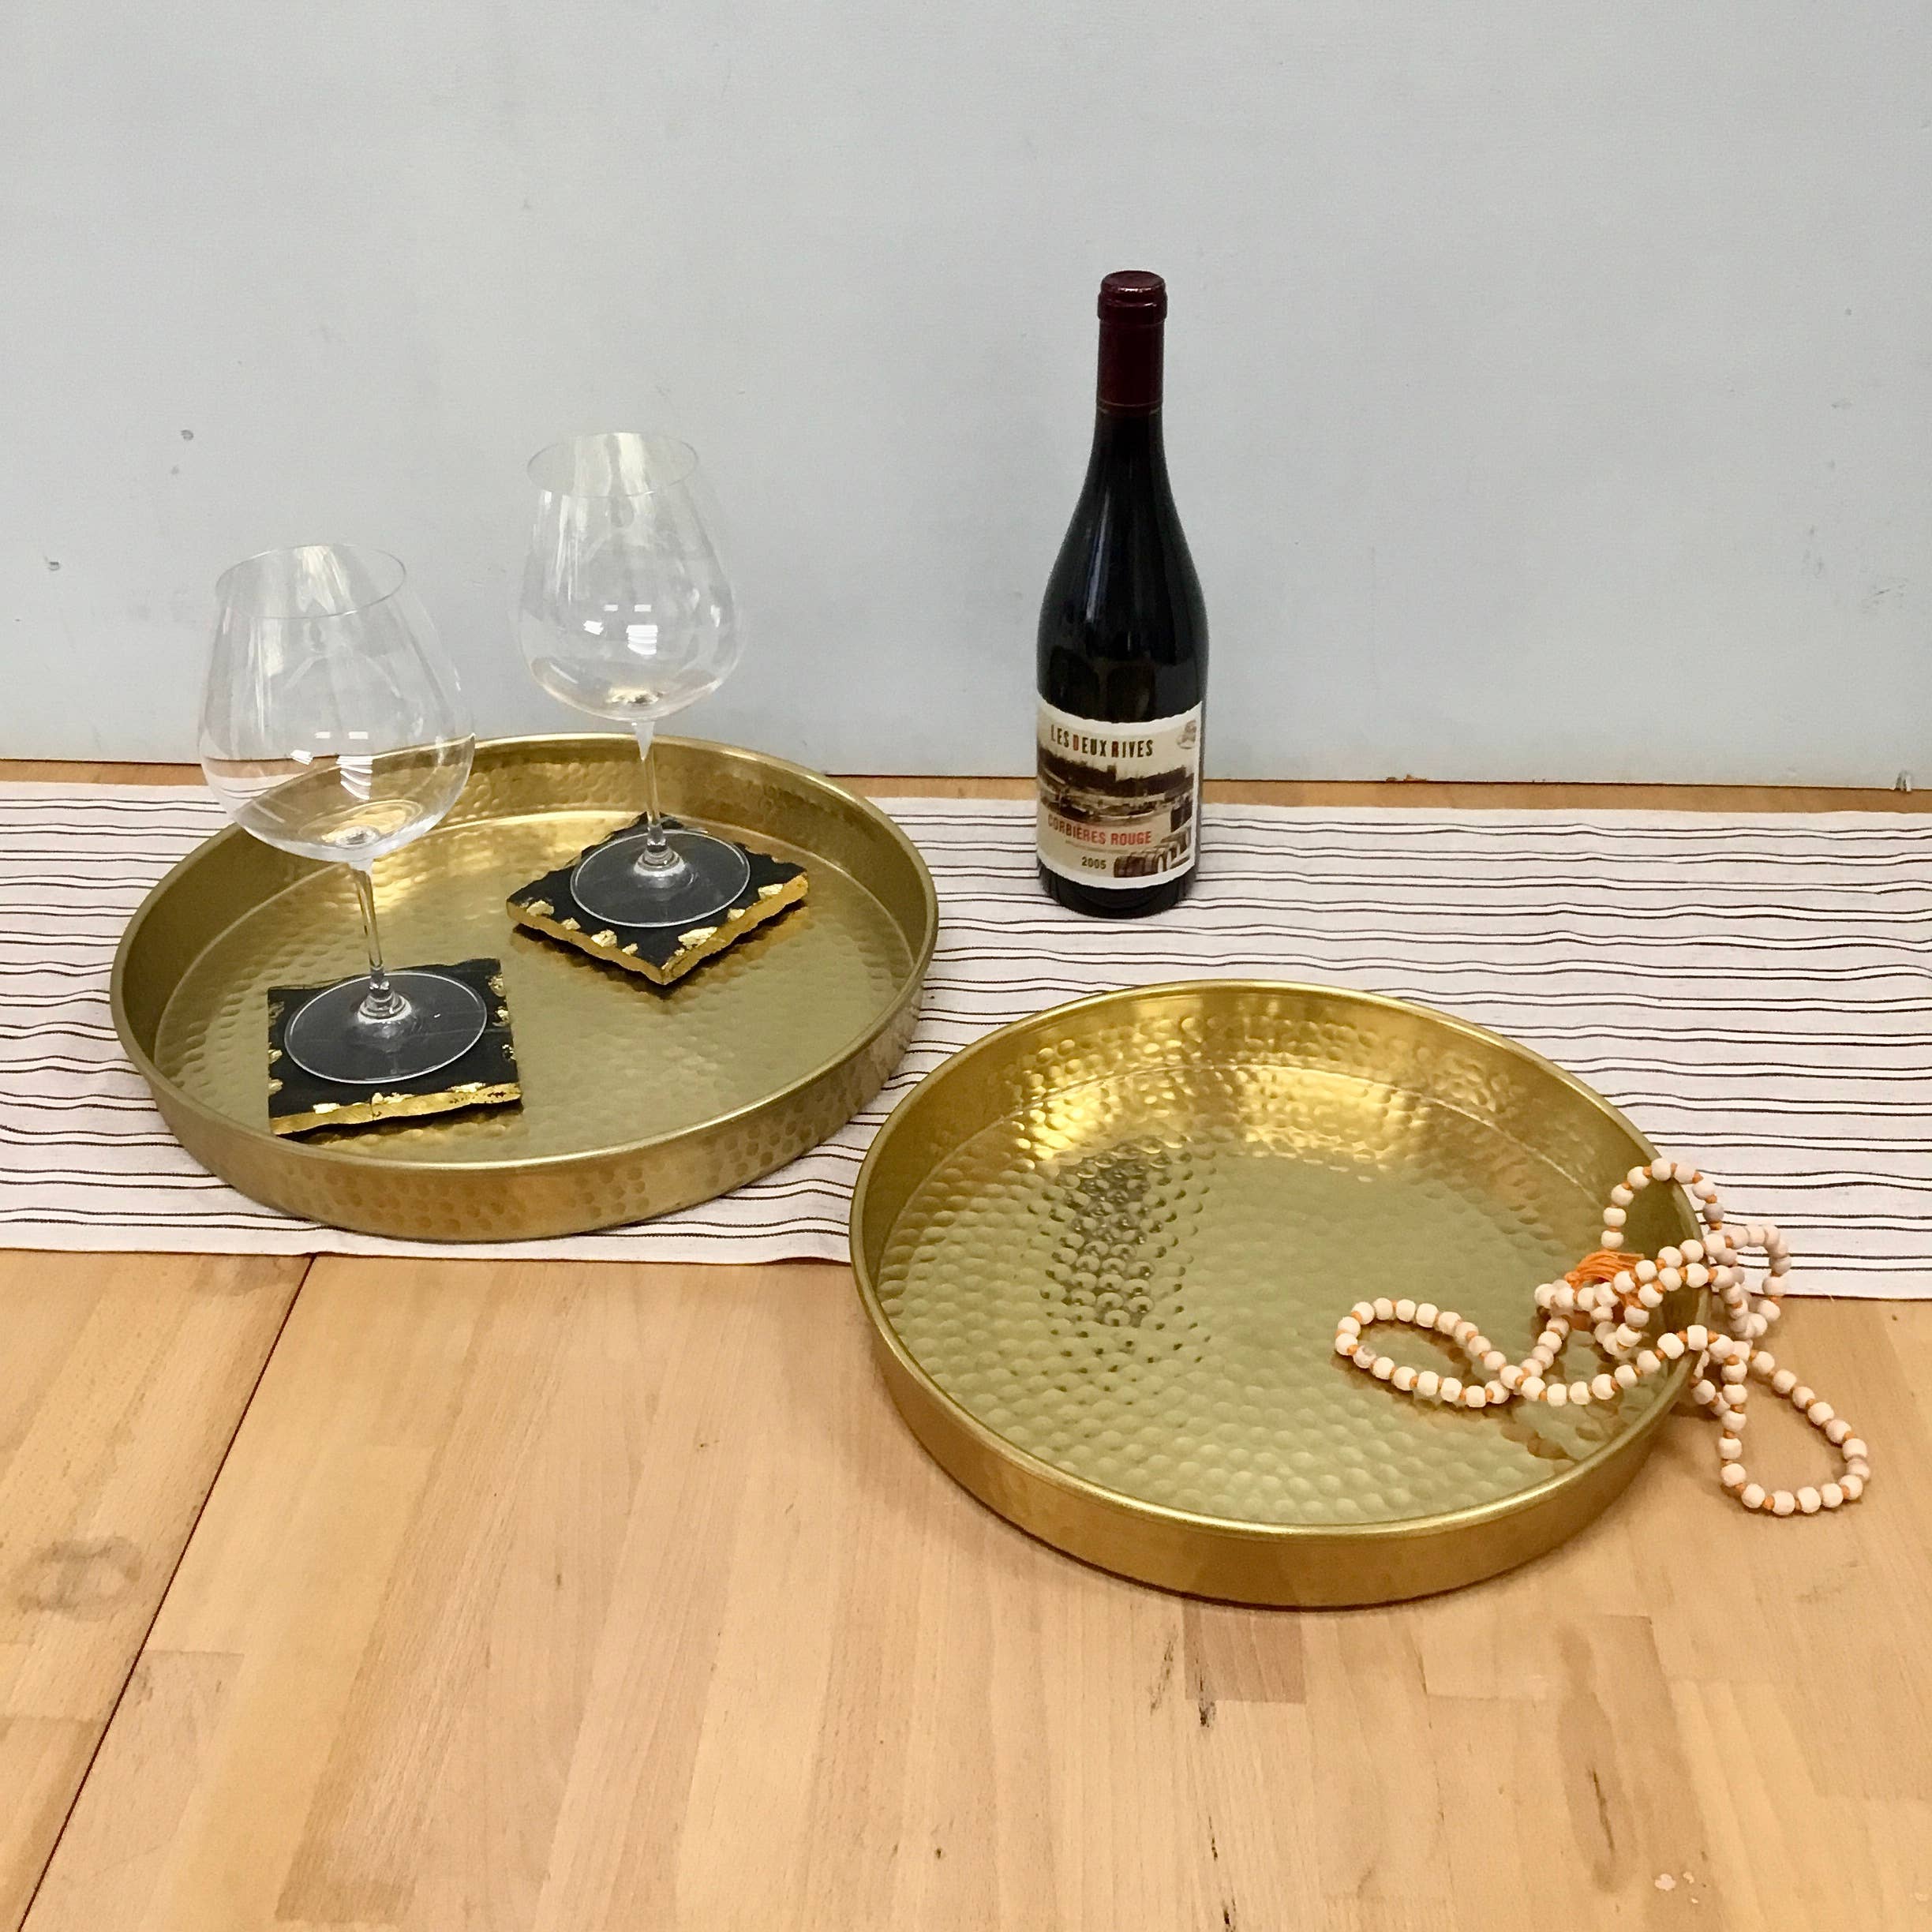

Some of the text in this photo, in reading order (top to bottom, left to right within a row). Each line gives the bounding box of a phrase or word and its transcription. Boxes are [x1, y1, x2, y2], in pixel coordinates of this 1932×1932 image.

[1051, 725, 1154, 758] LES DEUX RIVES
[1048, 814, 1151, 846] CORBIÈRES ROUGE
[1081, 856, 1106, 870] 2005
